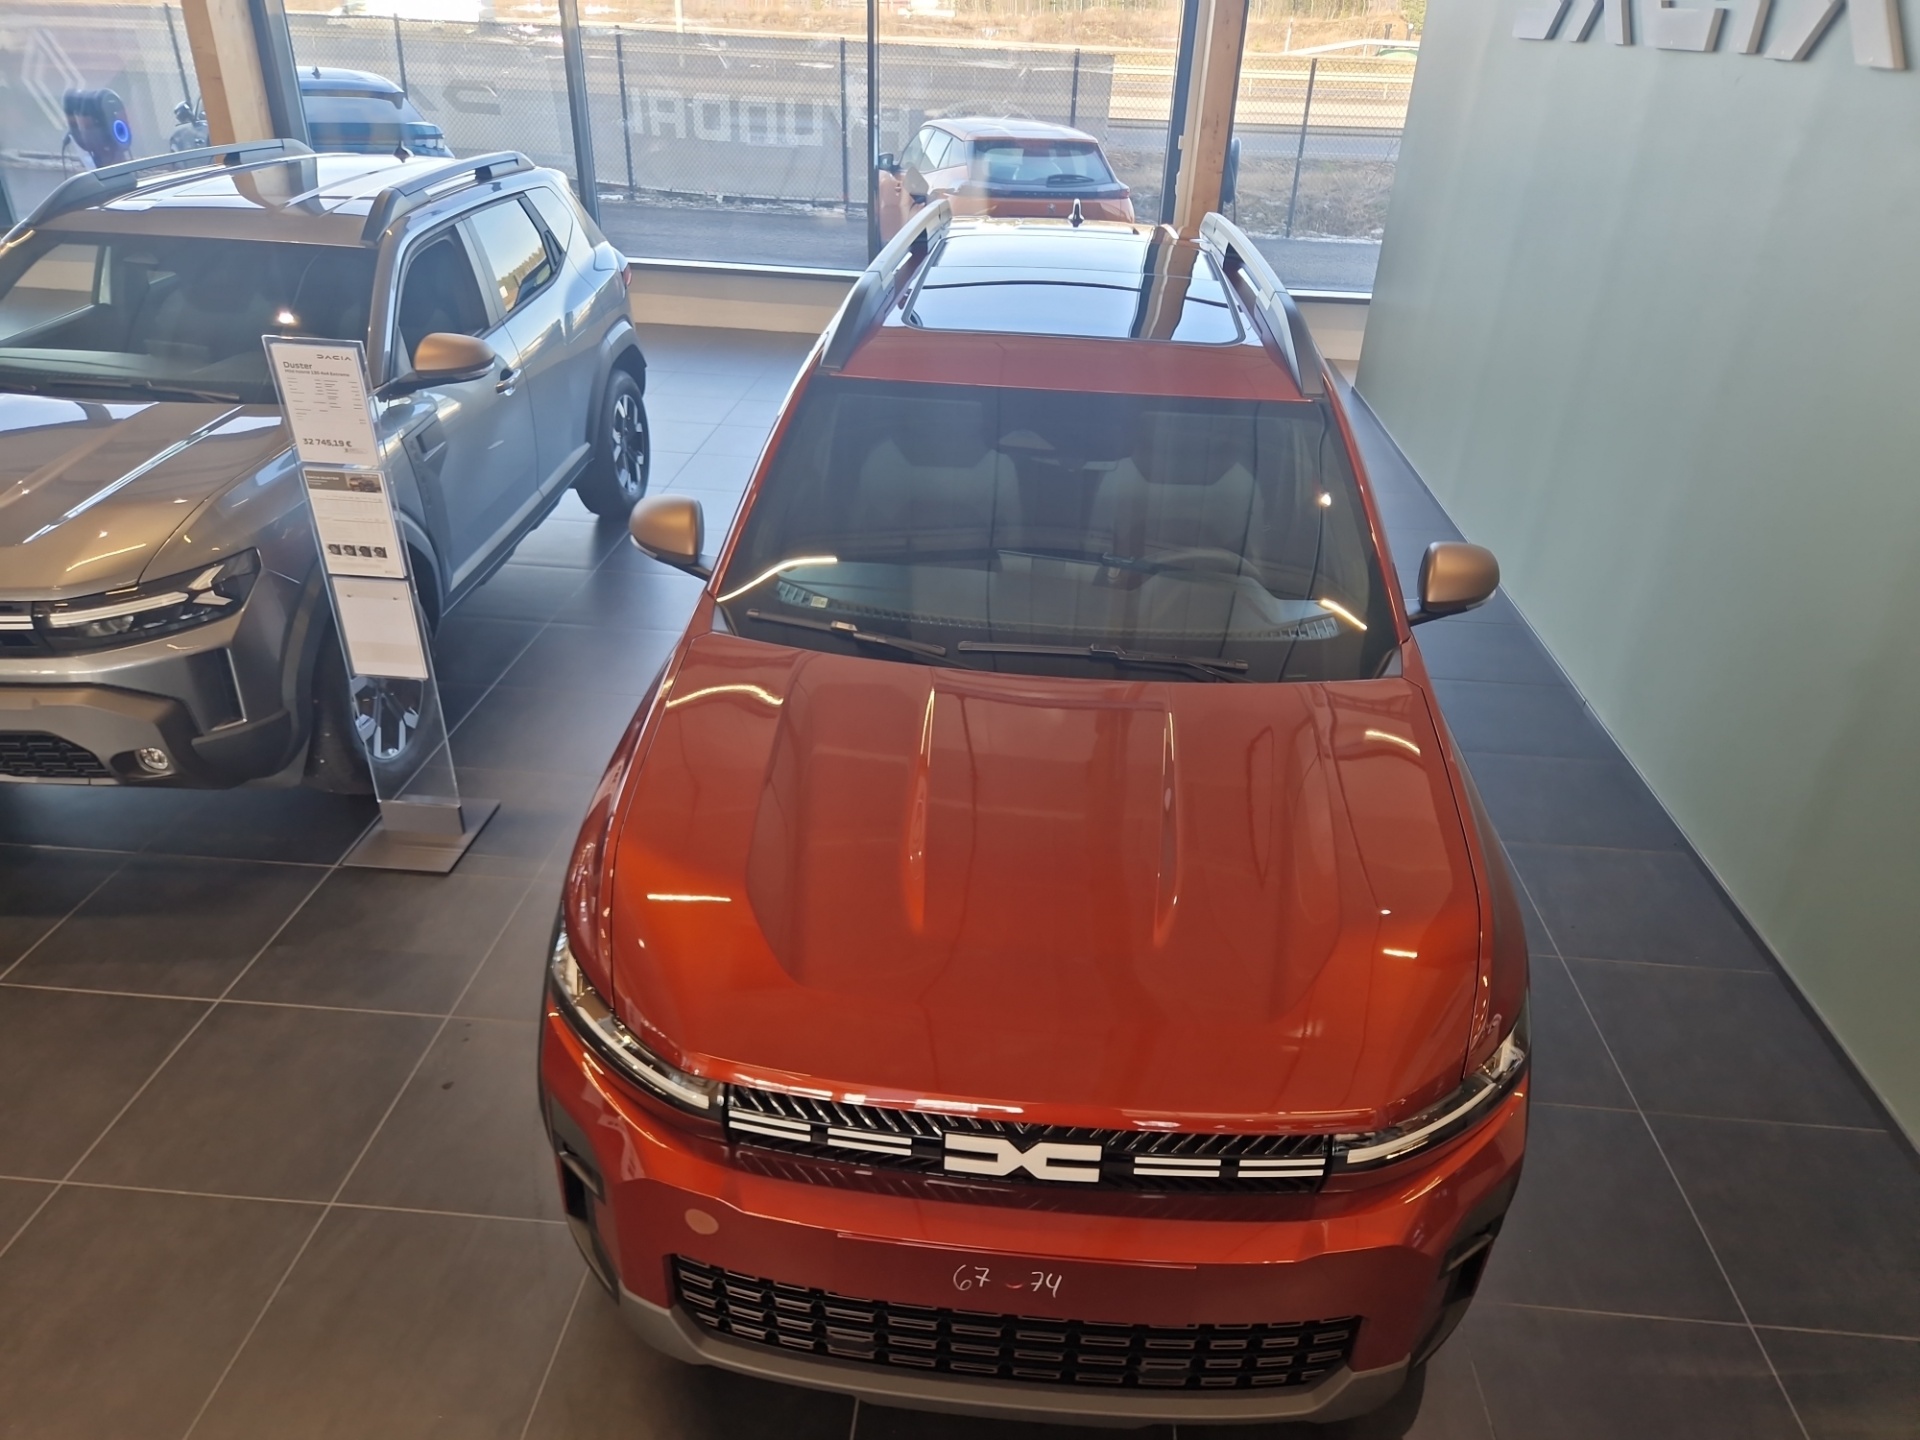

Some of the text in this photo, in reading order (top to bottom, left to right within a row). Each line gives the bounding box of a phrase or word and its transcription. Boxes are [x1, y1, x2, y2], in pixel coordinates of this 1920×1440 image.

[316, 353, 352, 361] DACIA
[283, 361, 312, 370] Duster
[303, 438, 314, 446] 32
[953, 1264, 1063, 1299] 67 74
